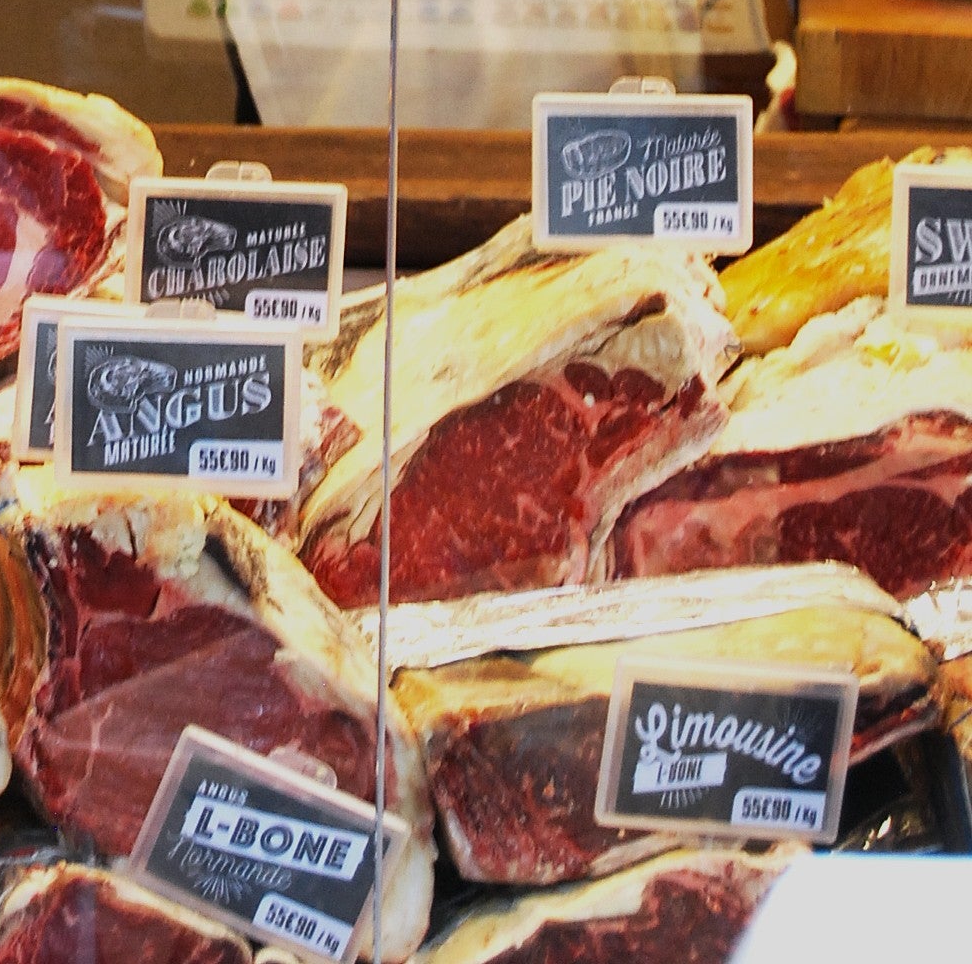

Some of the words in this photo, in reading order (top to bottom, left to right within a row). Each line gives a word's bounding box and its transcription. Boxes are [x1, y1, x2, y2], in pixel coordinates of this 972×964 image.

[561, 172, 616, 218] PIE
[625, 146, 727, 203] NOIRE
[148, 235, 326, 300] CHAROLAISE
[184, 355, 267, 385] NORMANDE
[87, 371, 271, 447] ANGUS
[635, 703, 822, 785] Limousine
[194, 806, 351, 870] L-BONE
